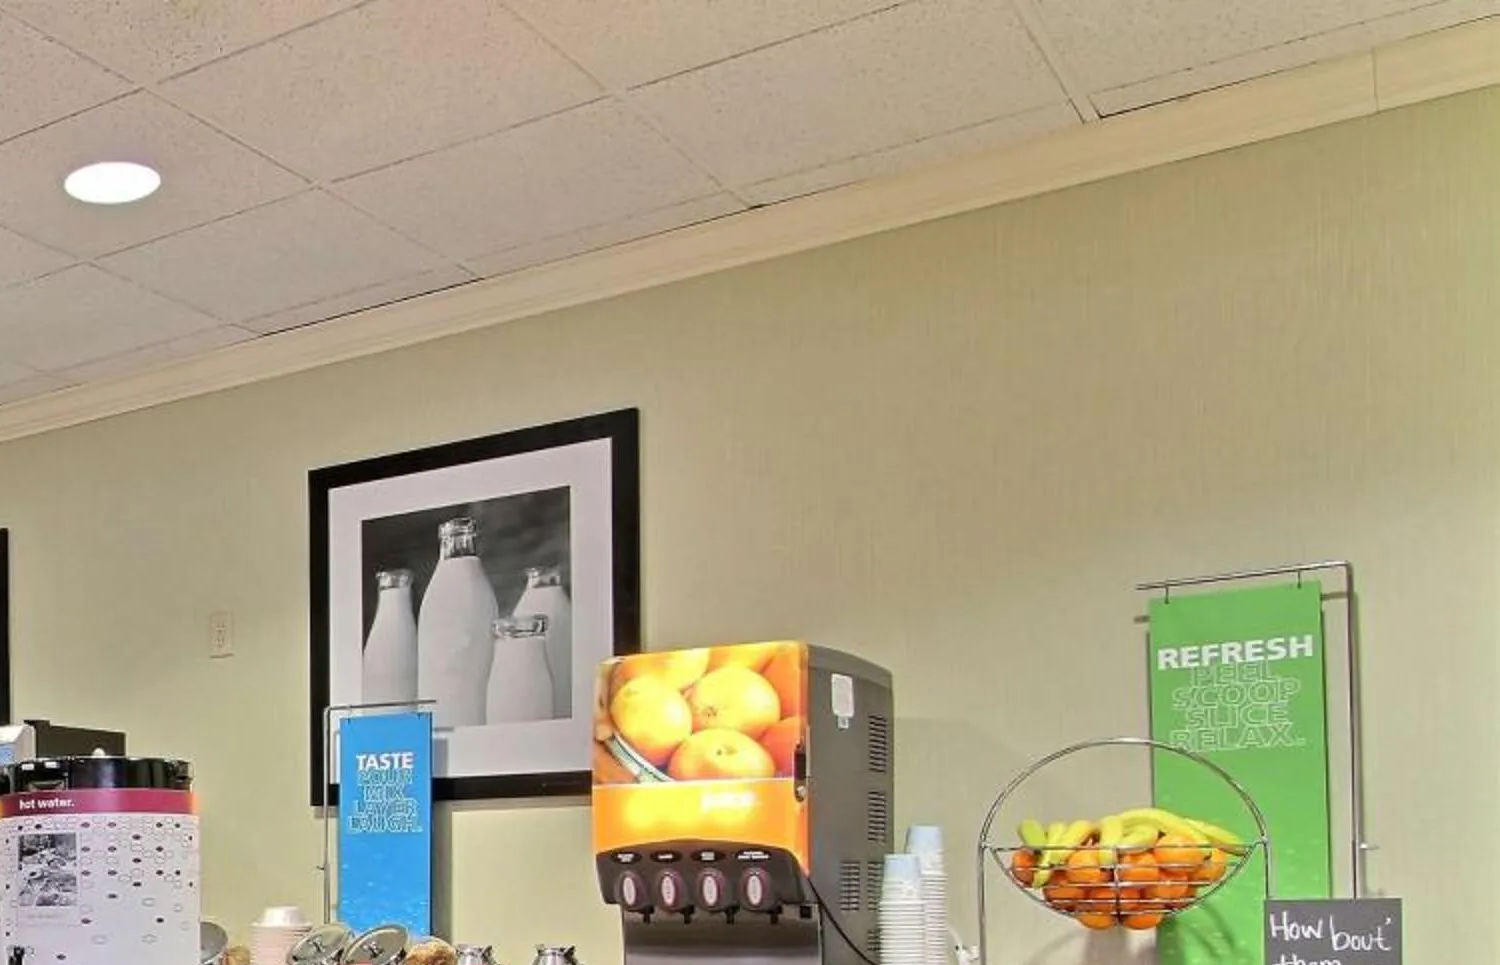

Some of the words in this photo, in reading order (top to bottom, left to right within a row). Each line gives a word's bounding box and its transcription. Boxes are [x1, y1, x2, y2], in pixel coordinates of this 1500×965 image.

[1157, 634, 1313, 671] REFRESH
[1190, 660, 1276, 688] PEEL
[1171, 677, 1301, 710] SCOOP
[1186, 701, 1290, 731] SLICE
[355, 752, 414, 771] TASTE
[18, 798, 36, 810] hot
[38, 796, 76, 809] water.
[1269, 910, 1323, 941] How
